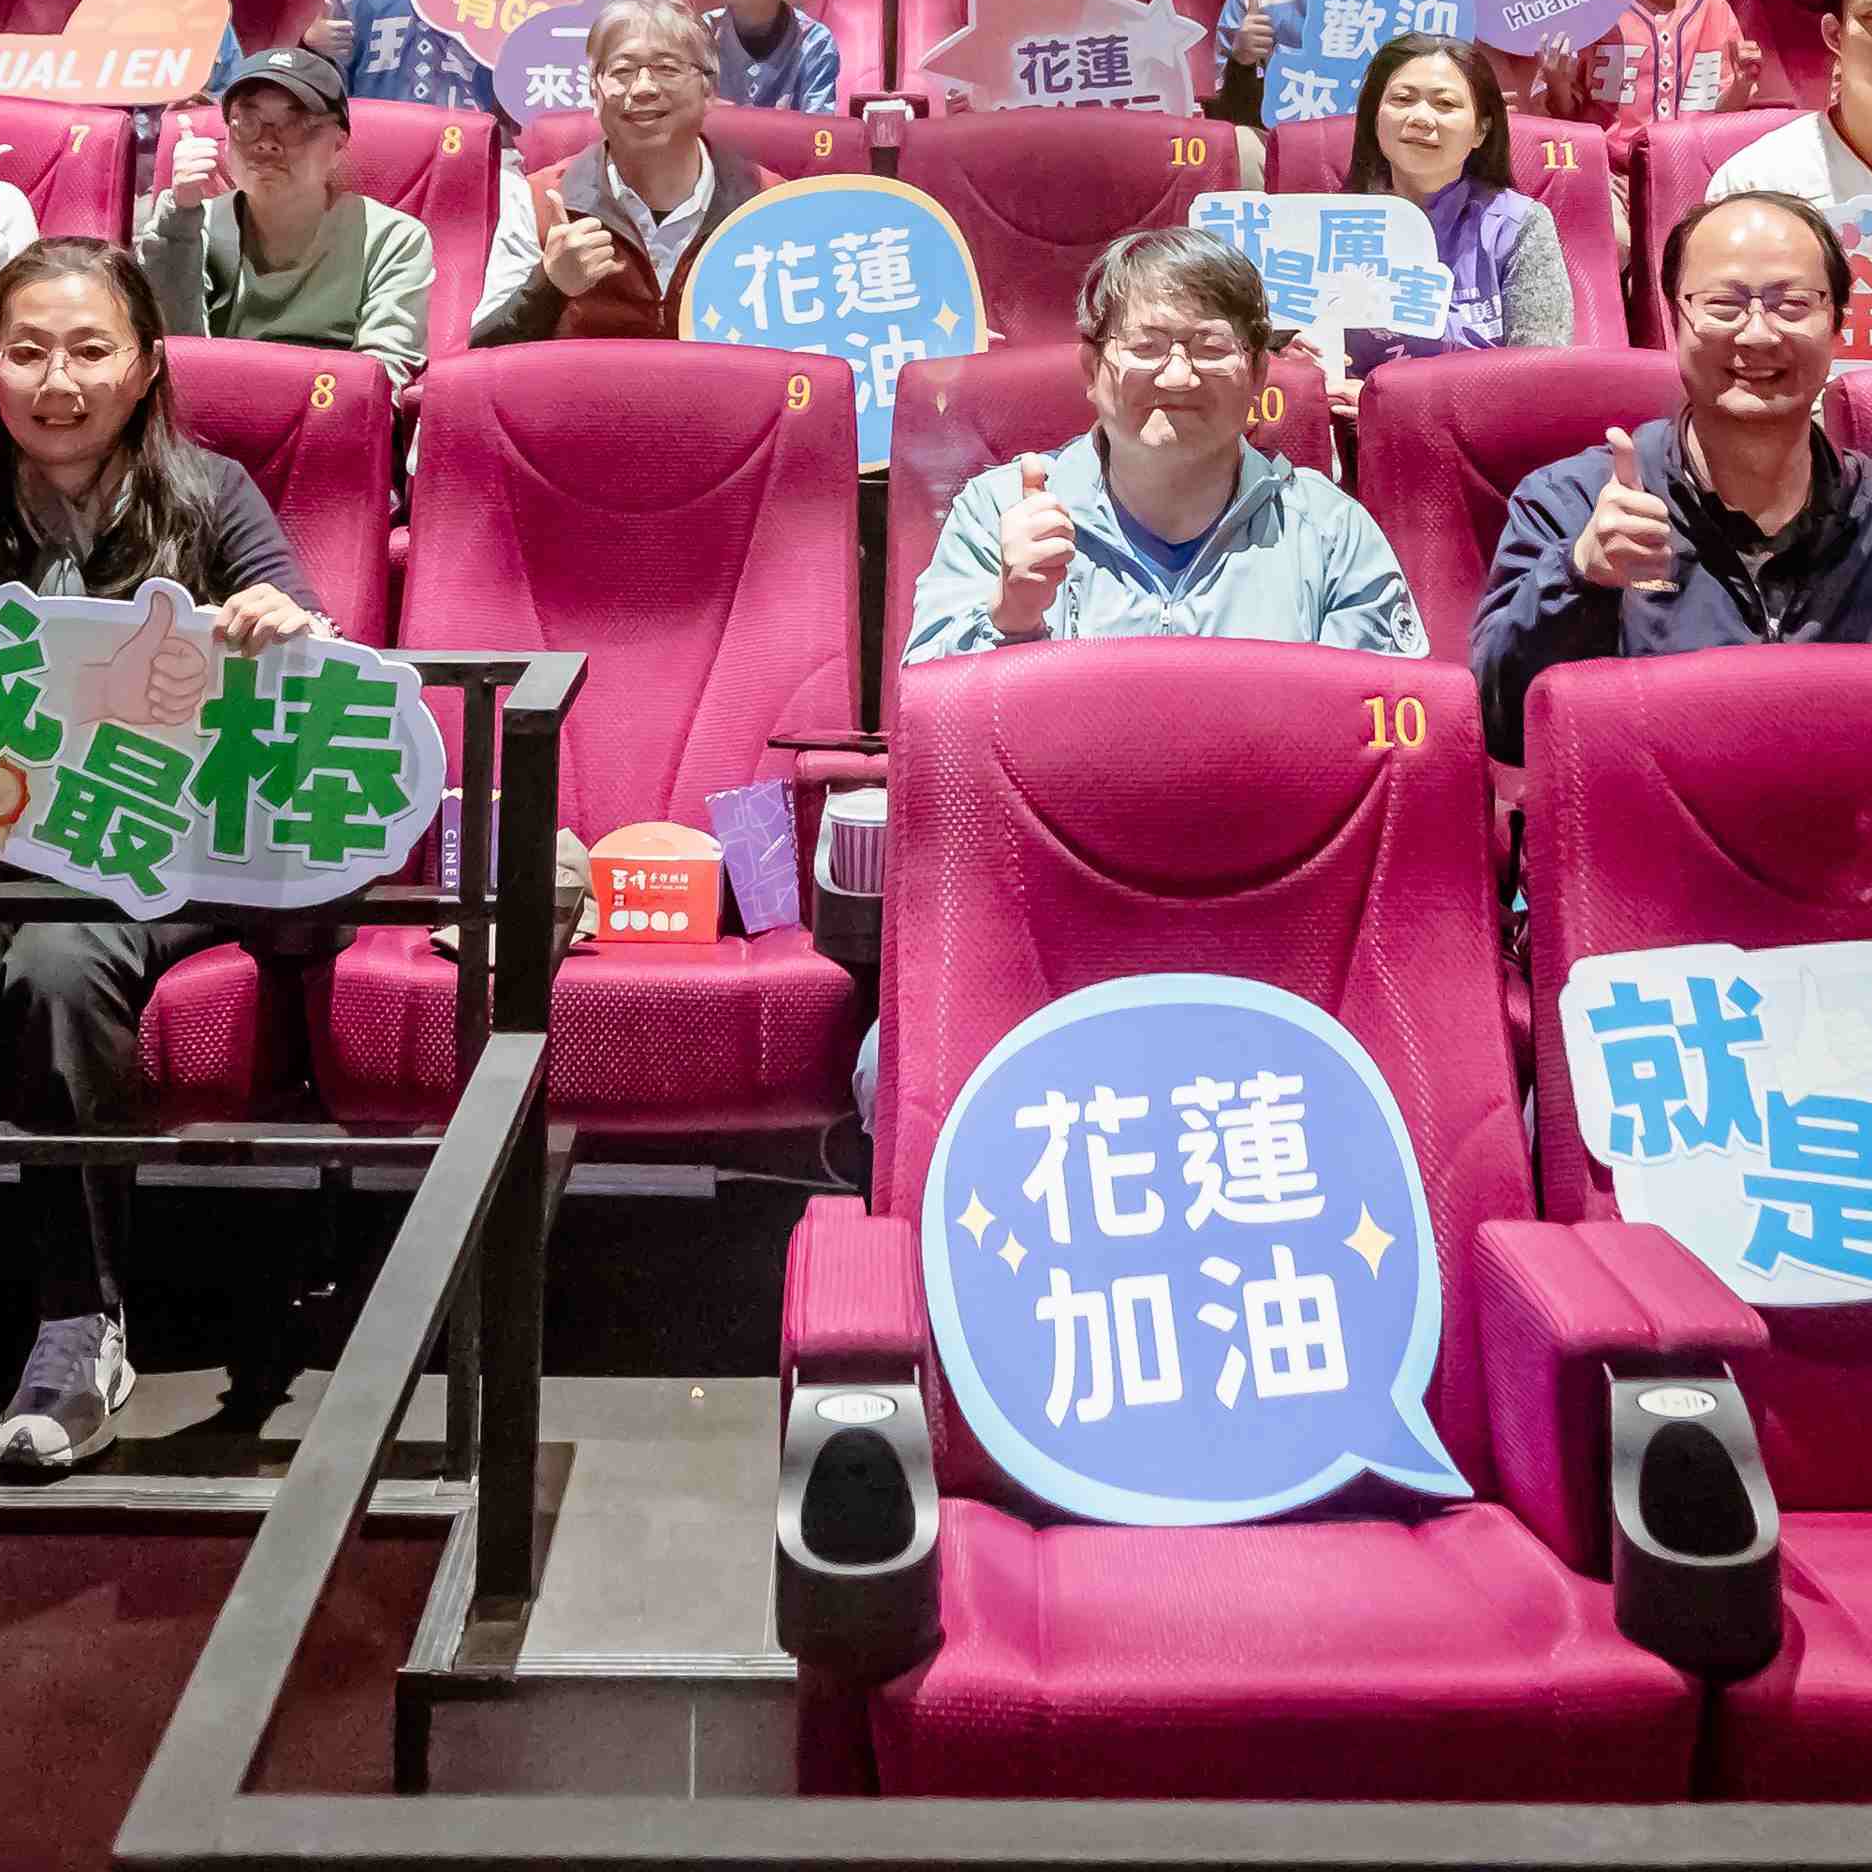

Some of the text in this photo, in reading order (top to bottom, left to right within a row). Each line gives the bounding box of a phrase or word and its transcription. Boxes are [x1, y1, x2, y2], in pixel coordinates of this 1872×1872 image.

[1017, 34, 1133, 95] 花蓮
[70, 125, 90, 153] 7
[441, 126, 463, 155] 8
[813, 130, 833, 157] 9
[1169, 136, 1206, 168] 10
[1540, 141, 1578, 171] 11
[734, 227, 921, 331] 花蓮
[1200, 201, 1448, 326] 就是厲害
[310, 373, 337, 410] 8
[786, 374, 812, 410] 9
[1362, 697, 1428, 751] 10
[1015, 1070, 1327, 1245] 花蓮
[1035, 1245, 1350, 1429] 加油
